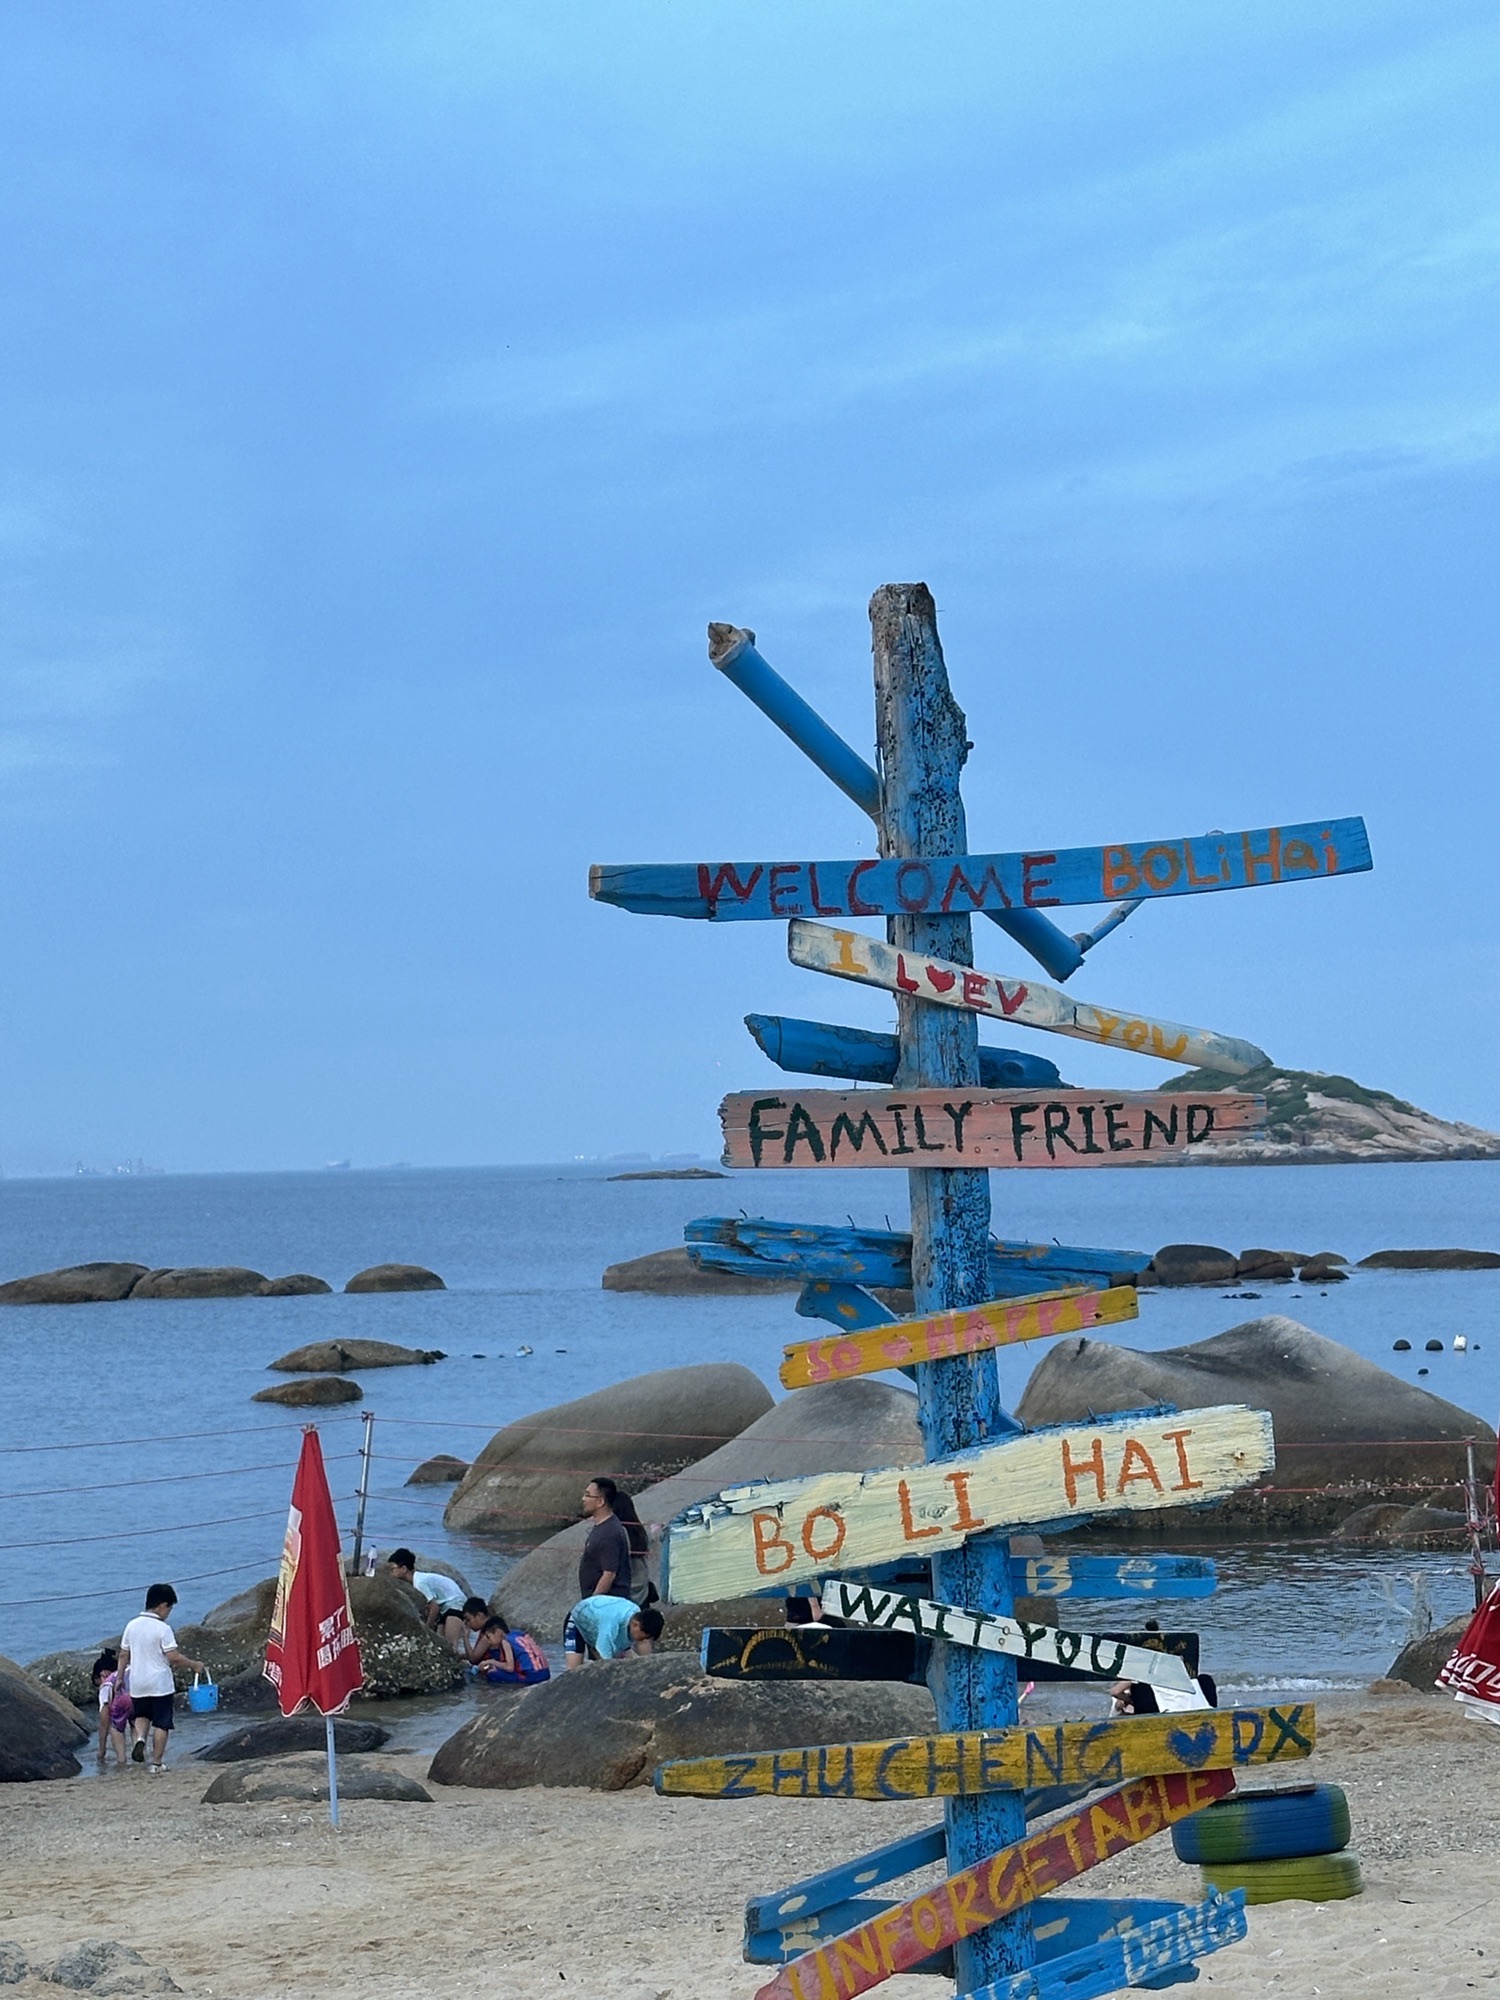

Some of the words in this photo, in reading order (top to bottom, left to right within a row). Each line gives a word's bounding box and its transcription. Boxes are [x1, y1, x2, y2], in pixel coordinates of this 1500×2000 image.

[698, 853, 1061, 917] WELCOME
[829, 932, 868, 974] I
[1092, 1008, 1189, 1059] YOU
[749, 1097, 974, 1168] FAMILY
[1010, 1100, 1217, 1161] FRIEND
[806, 1340, 862, 1383] SO
[925, 1292, 1101, 1357] HAPPY
[753, 1505, 846, 1576] BO
[897, 1471, 986, 1541] LI
[1061, 1428, 1203, 1508] HAI
[839, 1583, 998, 1646] WAIT
[1016, 1619, 1127, 1677] YOU
